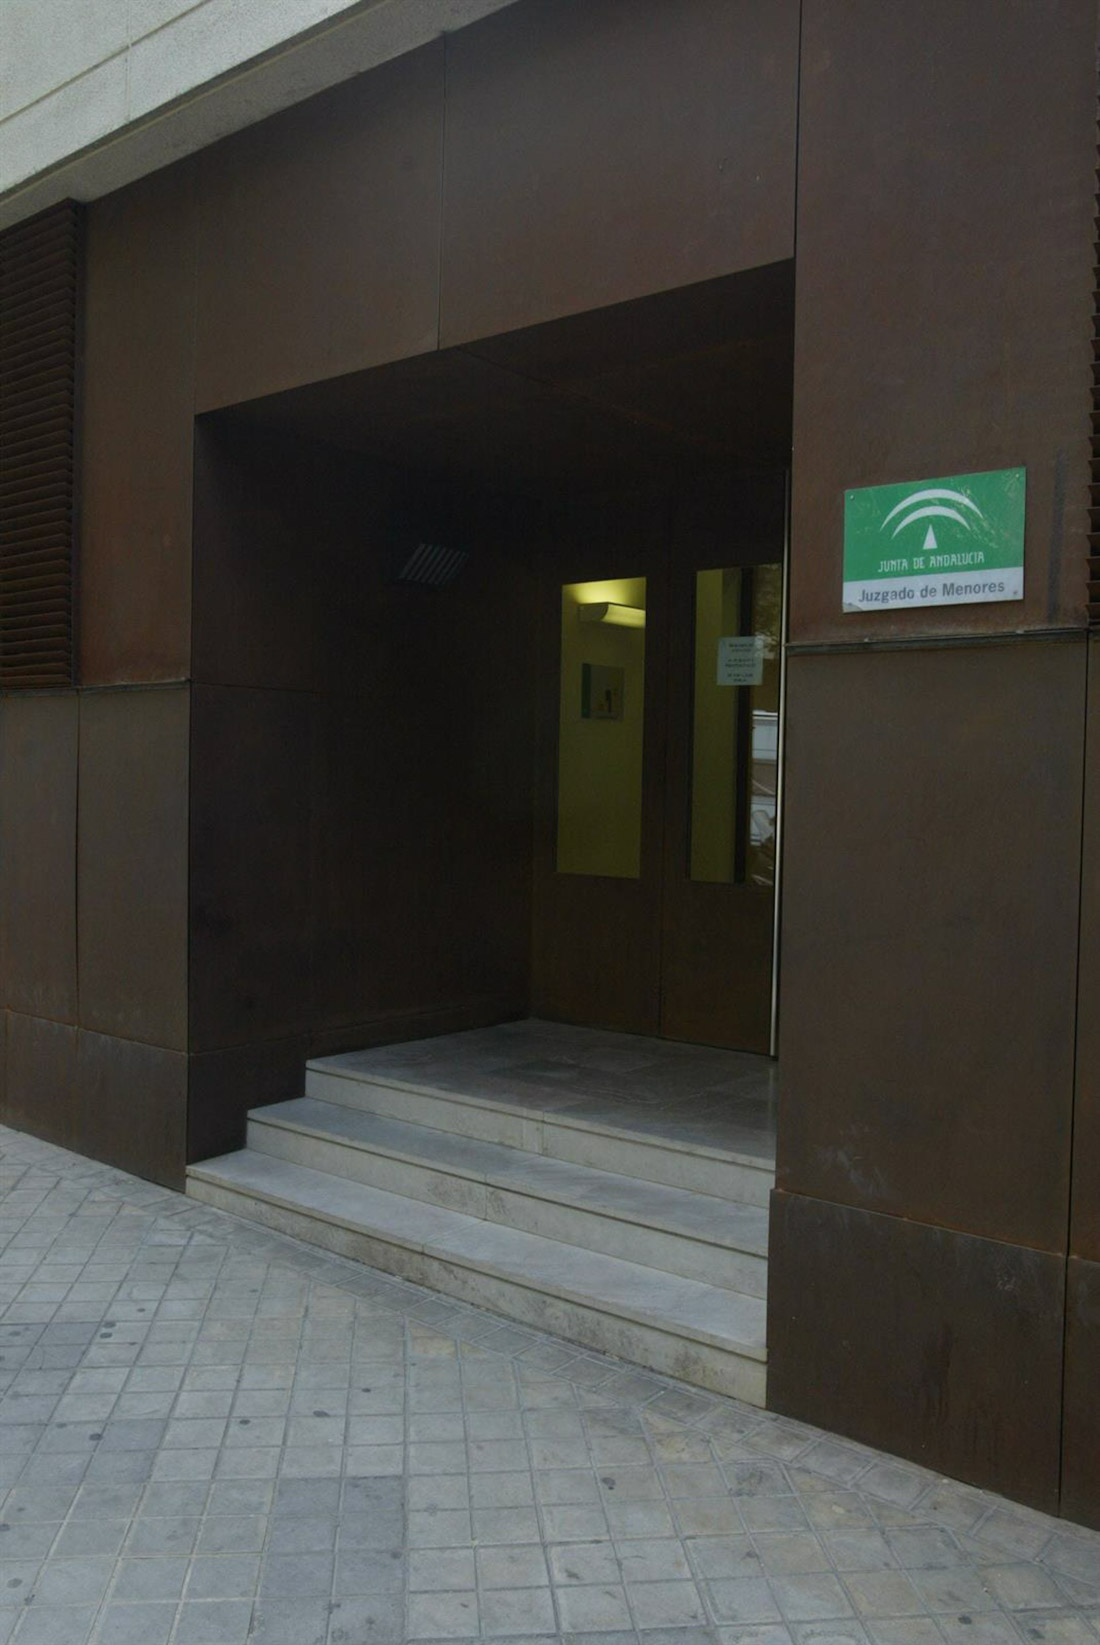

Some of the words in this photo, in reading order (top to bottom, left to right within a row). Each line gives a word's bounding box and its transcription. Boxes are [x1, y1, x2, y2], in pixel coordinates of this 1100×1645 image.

[878, 558, 908, 572] JUNTA
[913, 557, 925, 569] DE
[930, 551, 984, 567] ANDALUCIA
[859, 587, 914, 603] Juzgado
[920, 585, 937, 598] de
[942, 581, 1004, 596] Menores
